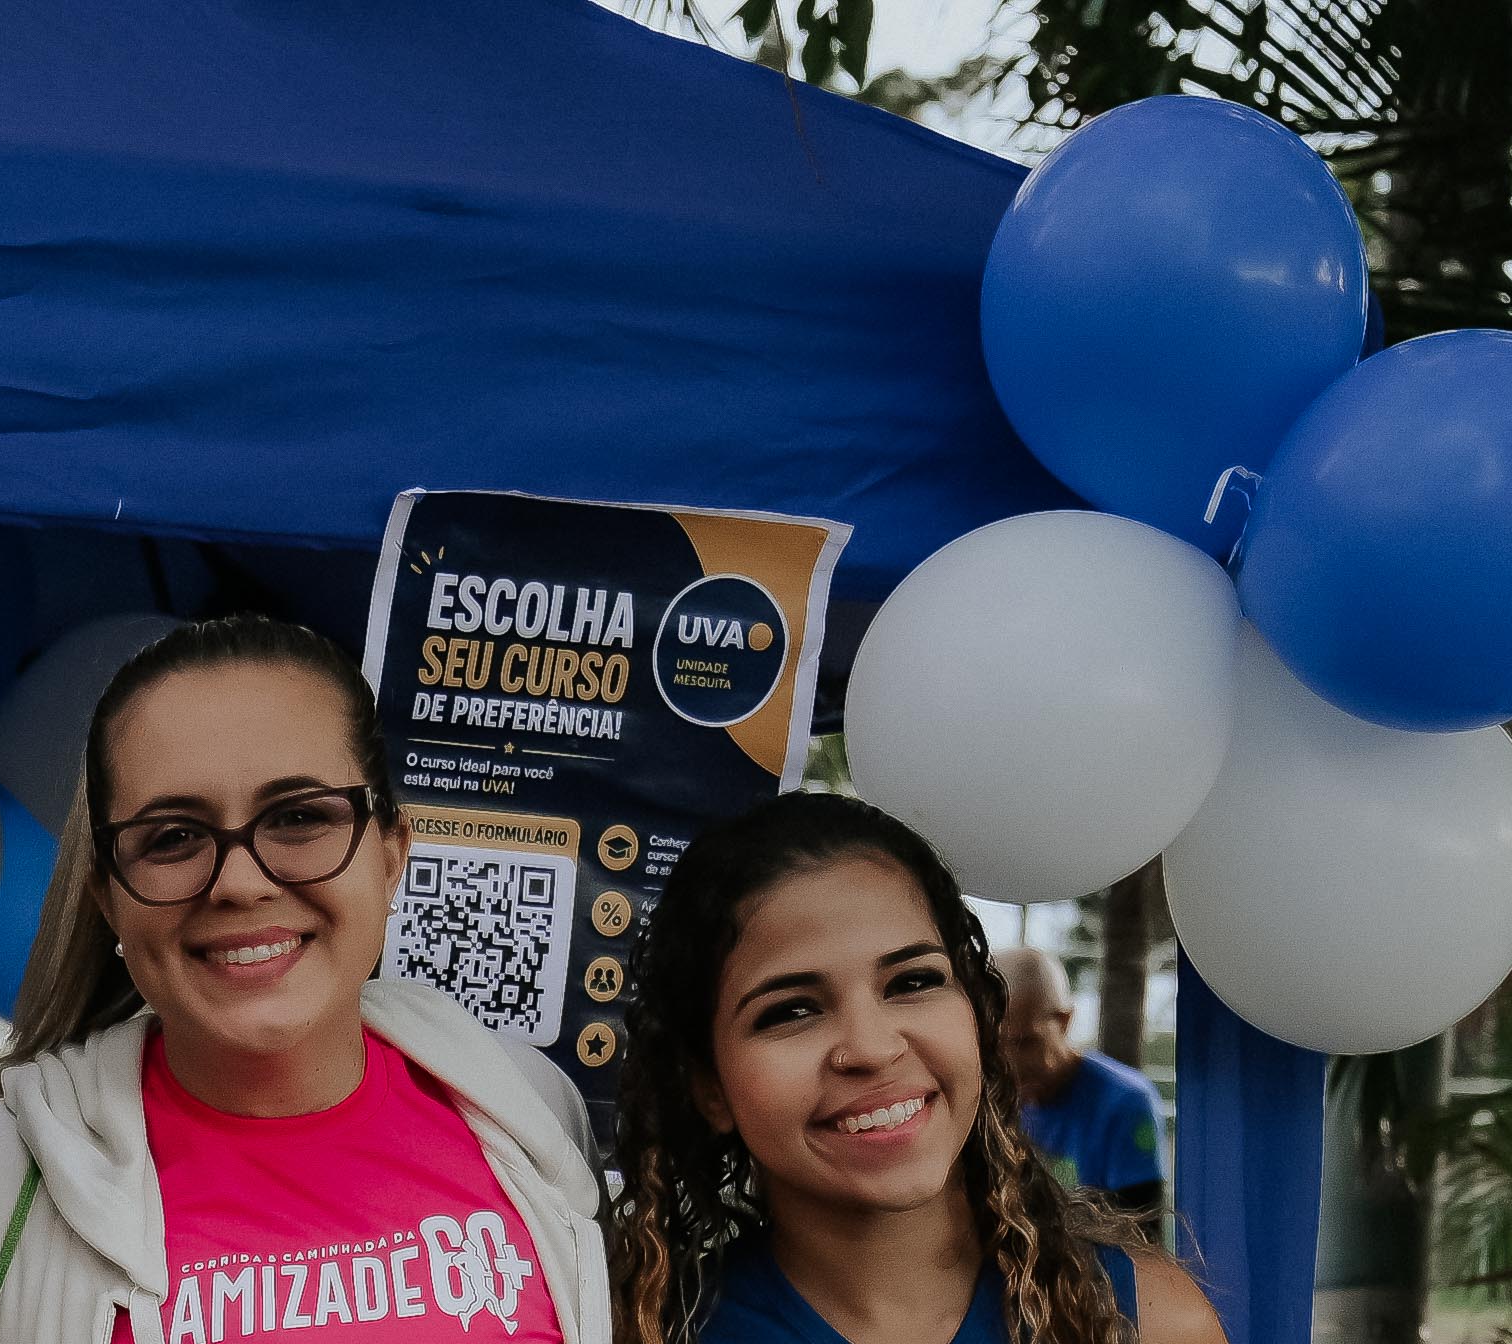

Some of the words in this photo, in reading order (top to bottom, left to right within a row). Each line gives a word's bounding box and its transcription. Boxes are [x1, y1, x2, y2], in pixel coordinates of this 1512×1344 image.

[427, 573, 633, 648] ESCOLHA
[678, 615, 744, 650] UVA
[419, 636, 494, 689] SEU
[500, 644, 629, 703] CURSO
[674, 674, 731, 689] MESQUITA
[677, 659, 728, 674] UNIDADE
[412, 693, 447, 722] DE
[451, 696, 623, 740] PREFERÊNCIA!
[407, 753, 417, 766] O
[421, 757, 456, 771] curso
[459, 758, 490, 773] ideal
[492, 765, 521, 776] para
[525, 767, 553, 779] você
[404, 773, 430, 786] está
[433, 776, 460, 791] aqui
[463, 780, 478, 791] na
[482, 779, 514, 794] UVA!
[462, 823, 474, 837] O
[477, 824, 568, 847] FORMULÁRIO
[181, 1254, 261, 1273] CORRIDA
[282, 1237, 387, 1262] CAMINHADA
[393, 1231, 416, 1244] DA
